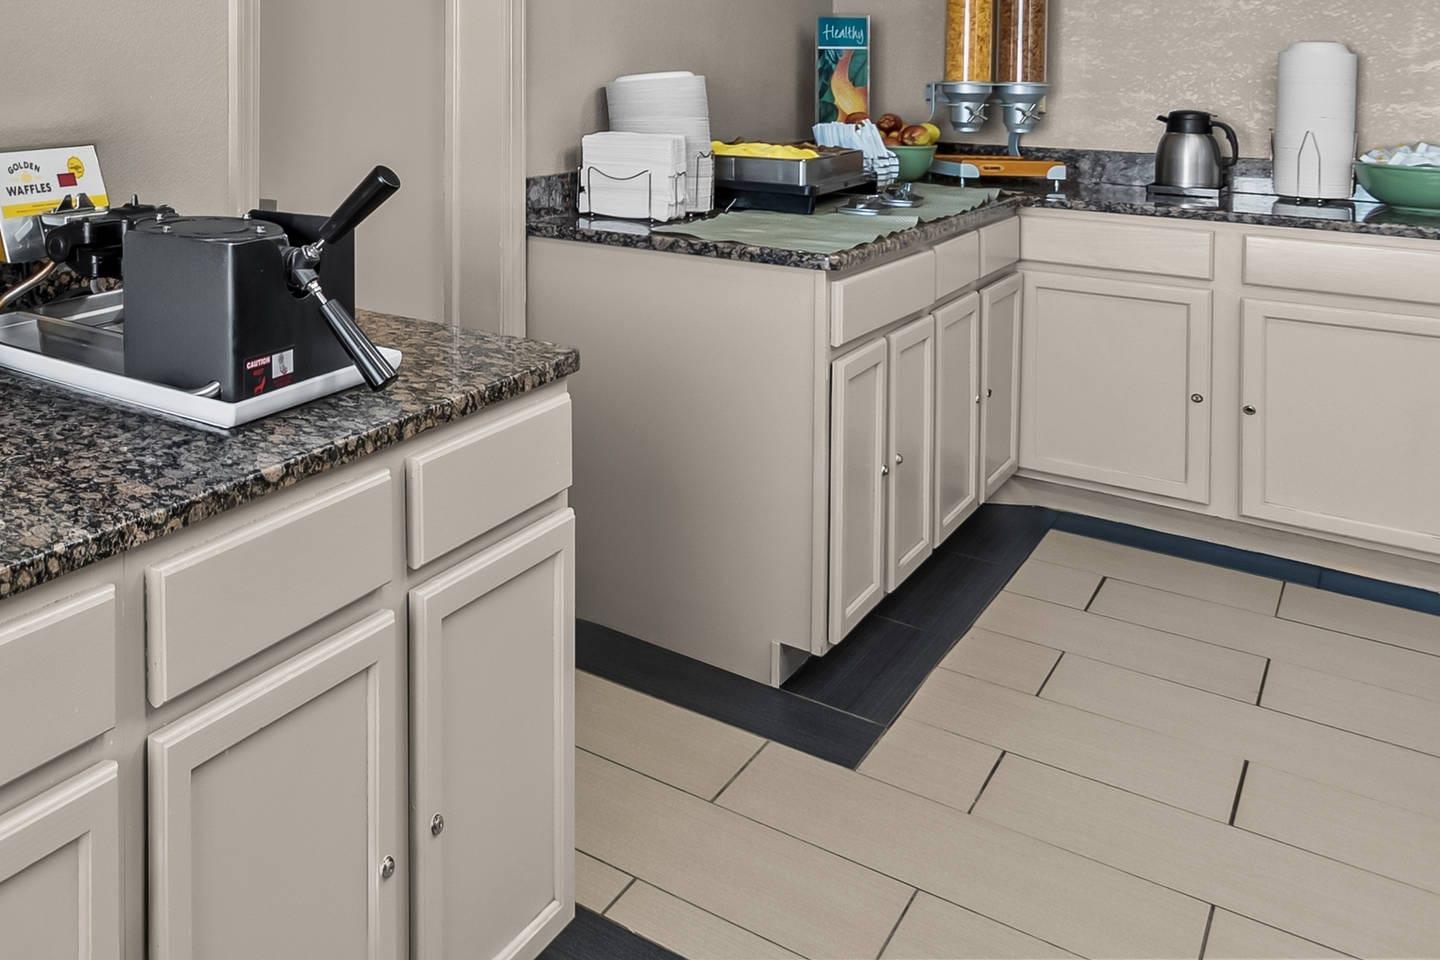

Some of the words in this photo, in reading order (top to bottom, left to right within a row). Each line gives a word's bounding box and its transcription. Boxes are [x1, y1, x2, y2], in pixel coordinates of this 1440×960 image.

[822, 23, 865, 45] Healthy
[7, 161, 41, 175] GOLDEN
[6, 182, 52, 196] WAFFLES
[246, 356, 271, 370] CAUTION
